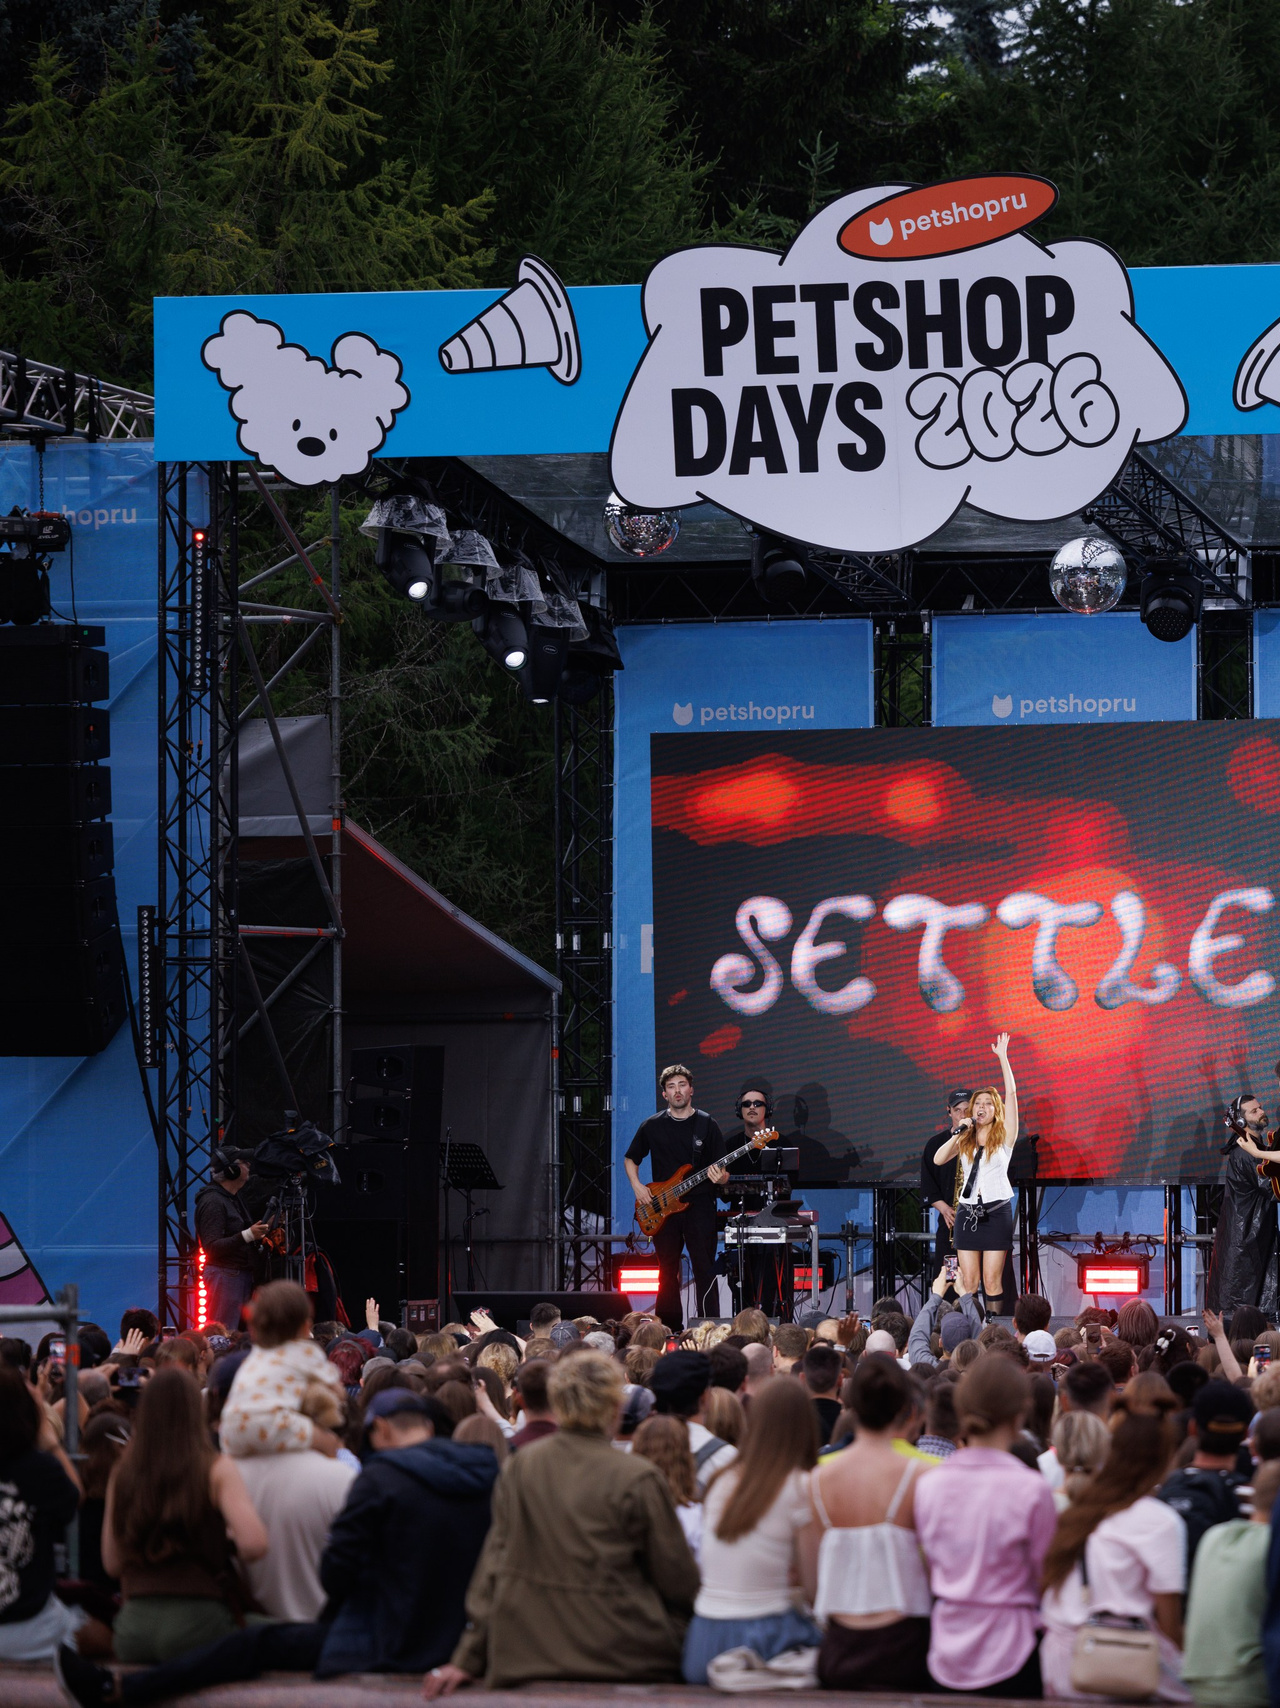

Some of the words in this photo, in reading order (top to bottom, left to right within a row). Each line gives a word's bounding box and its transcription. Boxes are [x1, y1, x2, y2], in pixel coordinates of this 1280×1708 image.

[899, 192, 1028, 241] petshopru
[700, 275, 1076, 377] PETSHOP
[671, 381, 886, 477] DAYS
[906, 352, 1120, 471] 2026
[62, 504, 137, 531] hopru
[700, 699, 816, 727] petshopru
[1020, 693, 1136, 718] petshopru
